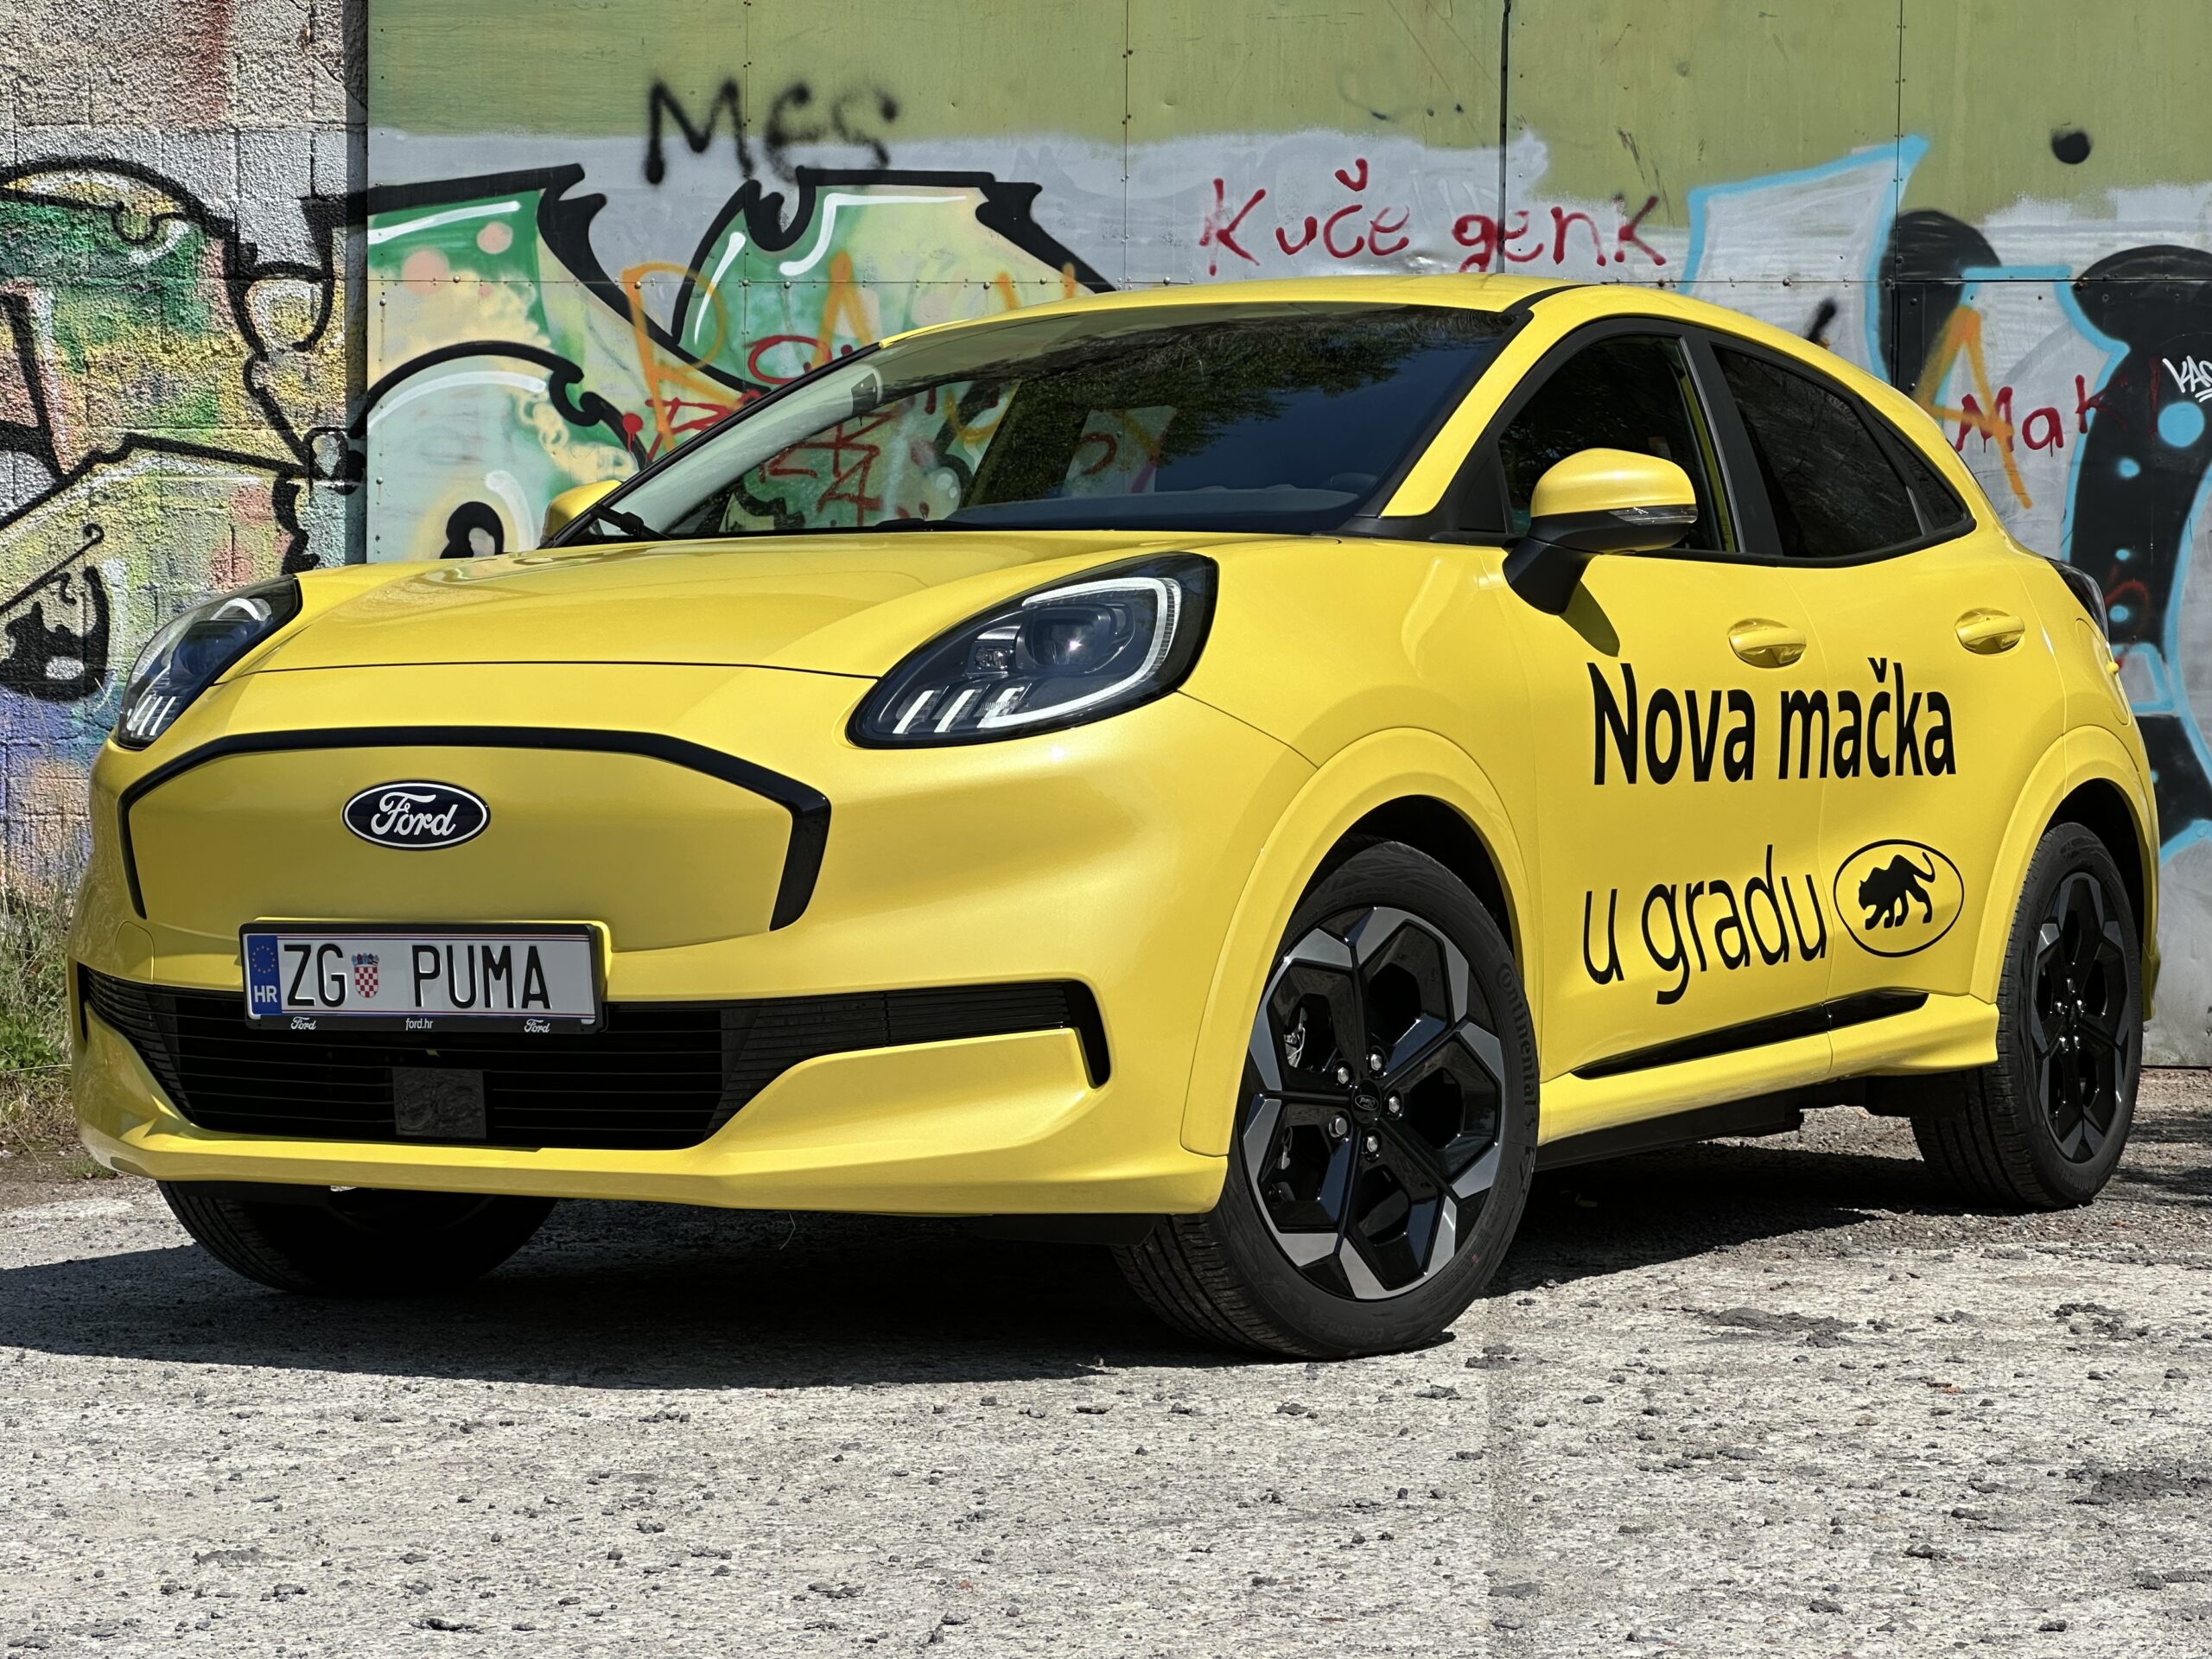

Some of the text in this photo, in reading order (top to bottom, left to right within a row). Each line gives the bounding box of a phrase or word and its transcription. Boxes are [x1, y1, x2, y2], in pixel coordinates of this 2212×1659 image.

[1586, 657, 1956, 785] Nova mačka
[371, 791, 457, 836] Ford
[1583, 844, 1827, 1005] u gradu
[254, 985, 277, 1003] HR
[284, 944, 551, 1009] ZG PUMA
[290, 1016, 316, 1030] Ford
[405, 1017, 433, 1030] ford.hr
[524, 1019, 550, 1033] Ford
[1498, 963, 1537, 1107] Continental
